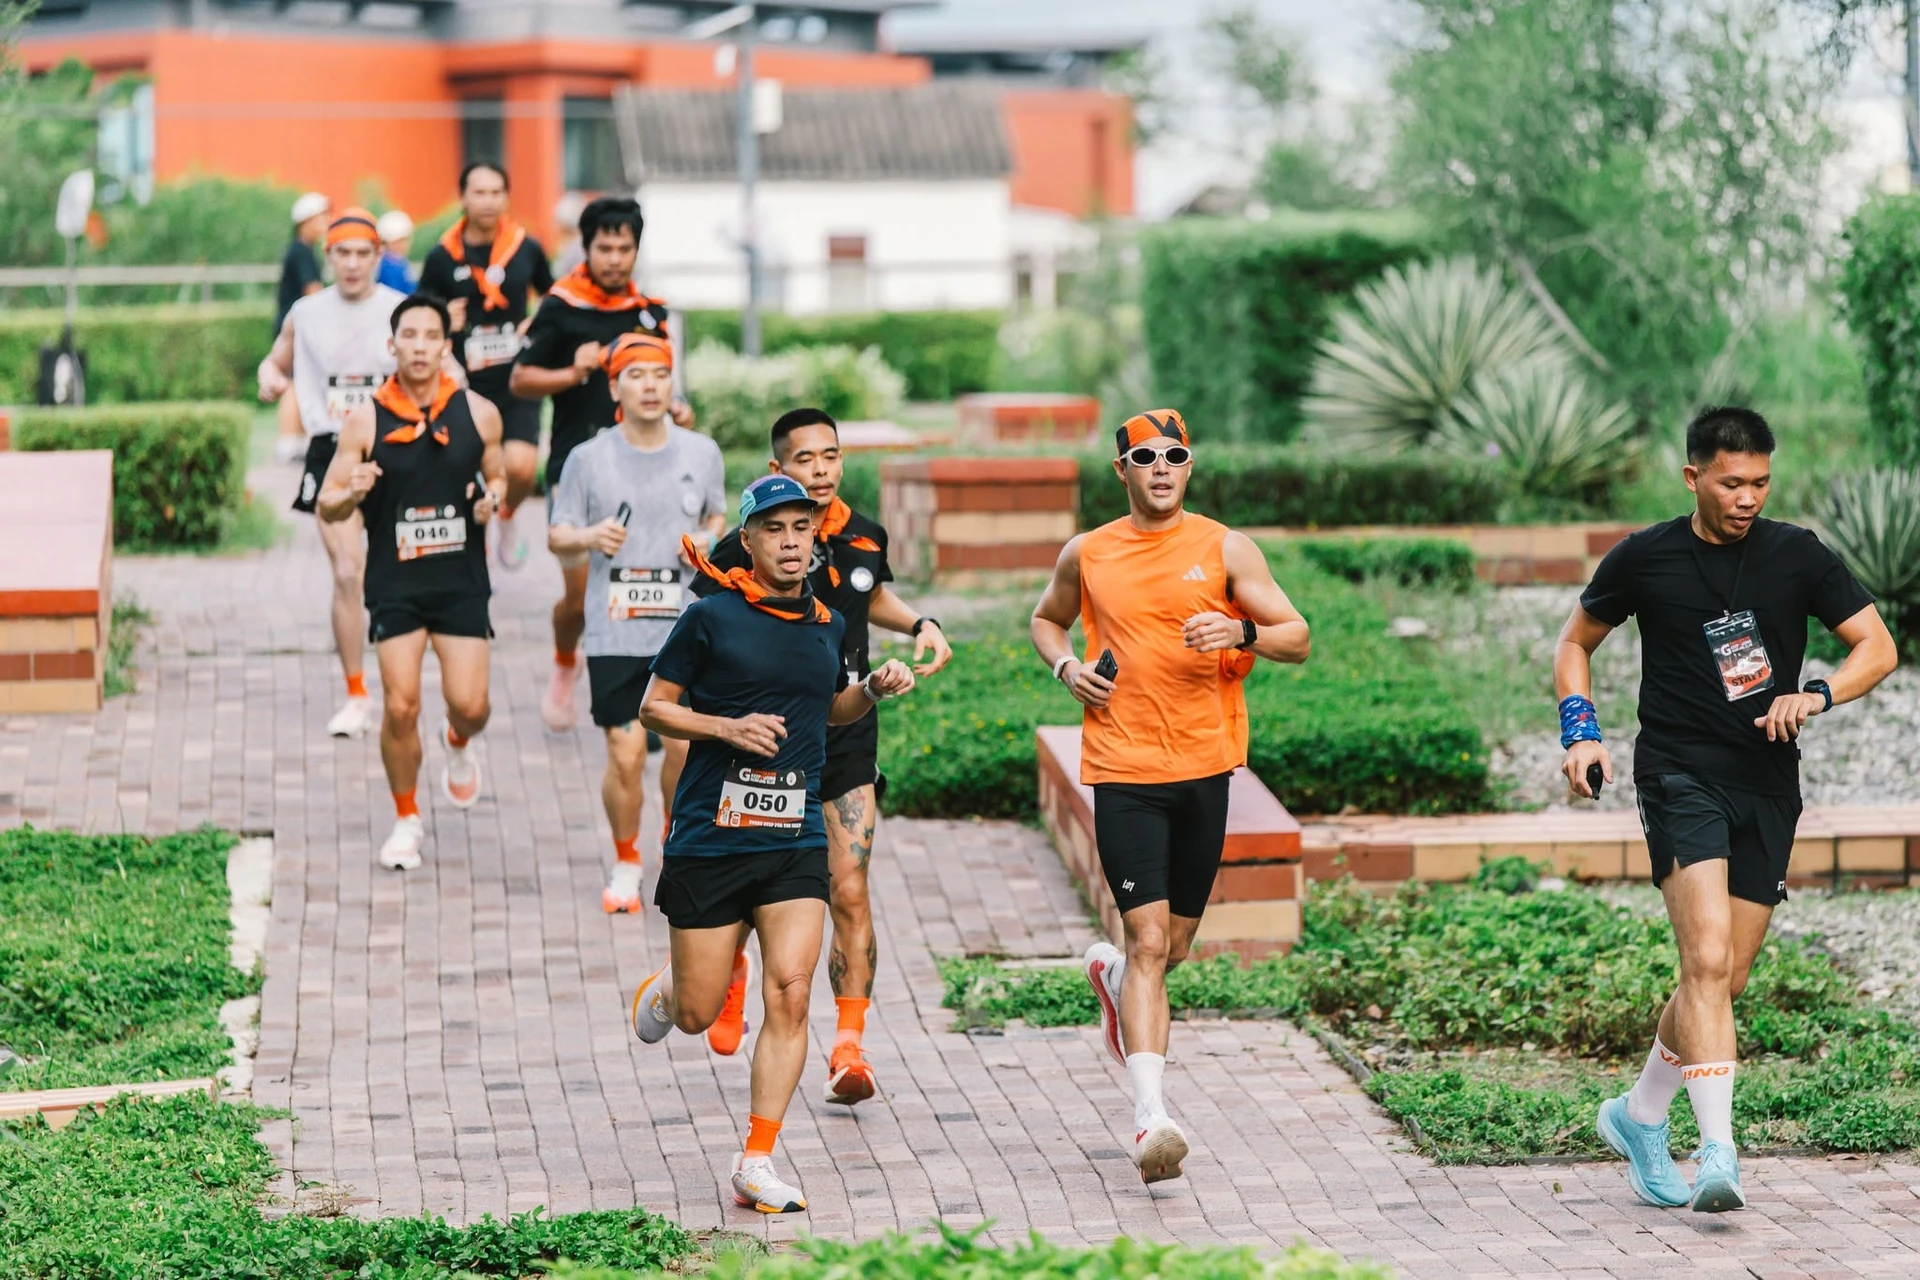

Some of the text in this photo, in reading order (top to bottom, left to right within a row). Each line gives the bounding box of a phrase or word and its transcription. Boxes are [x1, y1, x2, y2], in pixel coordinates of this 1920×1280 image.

[415, 527, 448, 540] 046
[628, 589, 663, 602] 020
[1731, 669, 1763, 687] STAFF
[743, 792, 788, 813] 050
